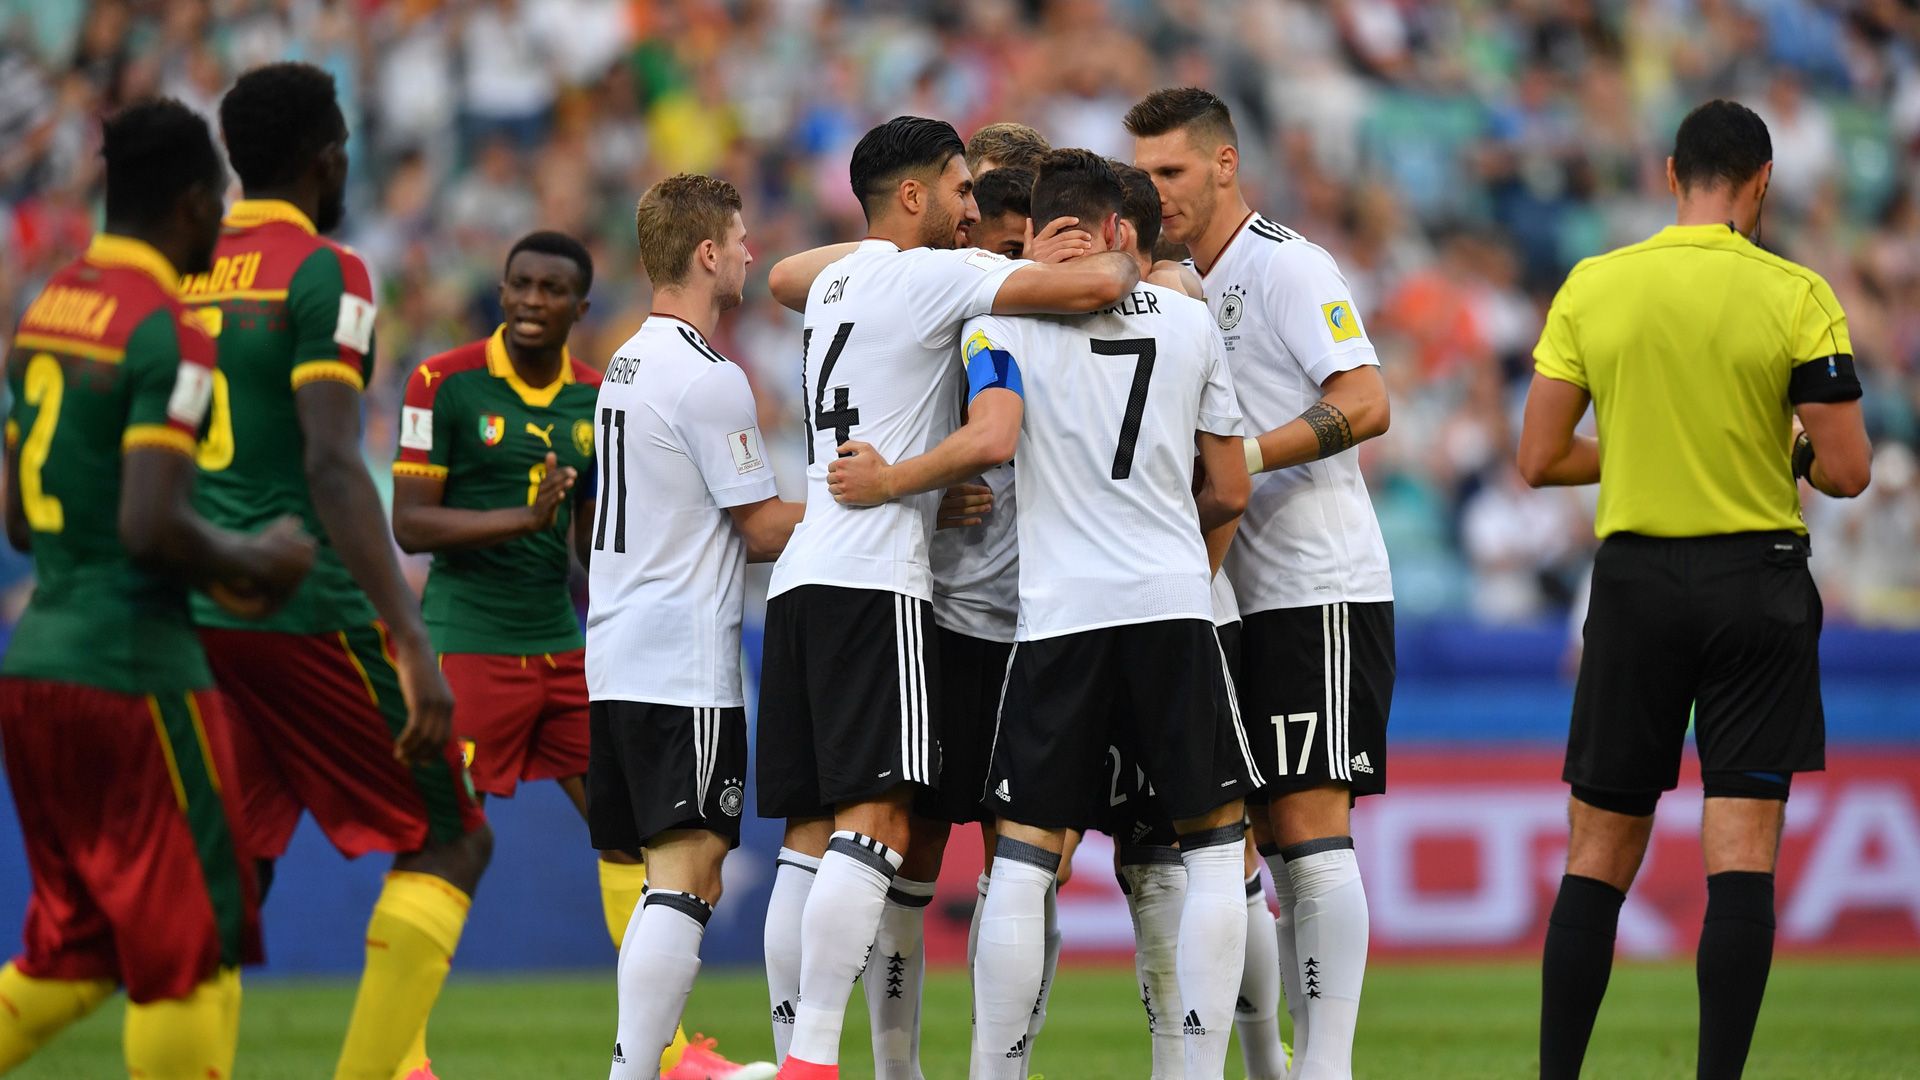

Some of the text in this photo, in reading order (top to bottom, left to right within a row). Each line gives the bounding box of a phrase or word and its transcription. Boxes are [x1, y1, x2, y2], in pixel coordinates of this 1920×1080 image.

[823, 275, 850, 304] CAN
[19, 352, 64, 532] 2
[604, 356, 641, 385] WERNER
[802, 322, 860, 466] 14
[1090, 337, 1157, 480] 7
[595, 407, 627, 554] 11
[1271, 712, 1318, 776] 17
